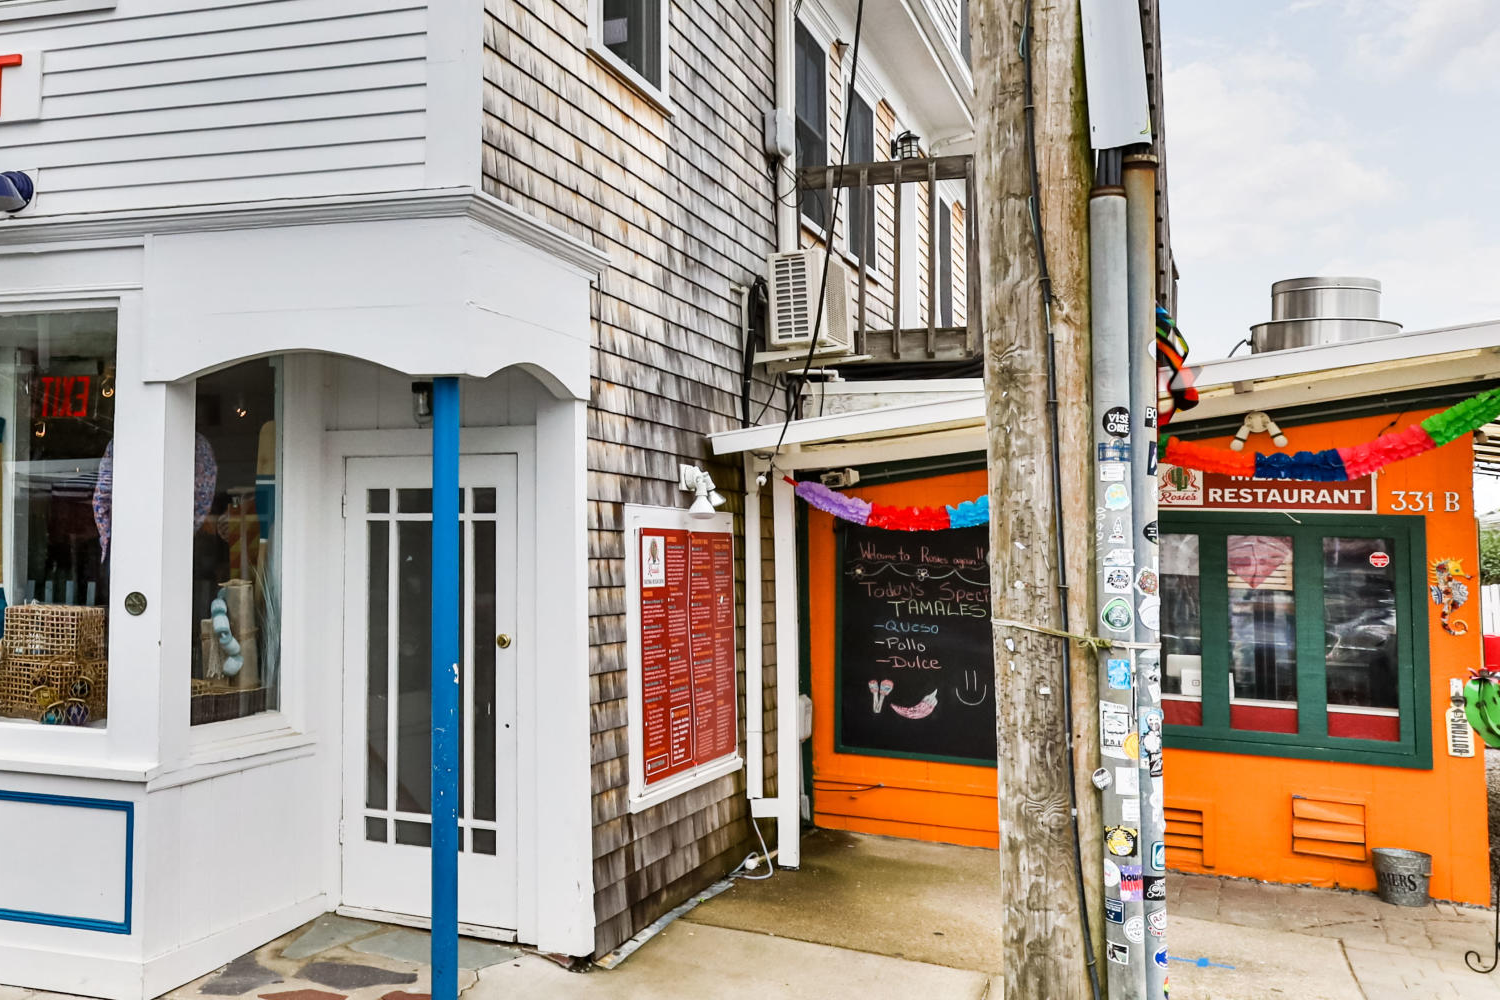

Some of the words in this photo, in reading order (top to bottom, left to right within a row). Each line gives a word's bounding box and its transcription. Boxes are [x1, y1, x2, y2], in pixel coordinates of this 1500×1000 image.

[1208, 488, 1366, 505] RESTAURANT
[1390, 490, 1435, 512] 331
[1444, 491, 1460, 512] B
[899, 546, 911, 561] to
[939, 582, 990, 603] Speci
[887, 599, 987, 618] TAMALES
[1450, 718, 1469, 753] BOTTOMS
